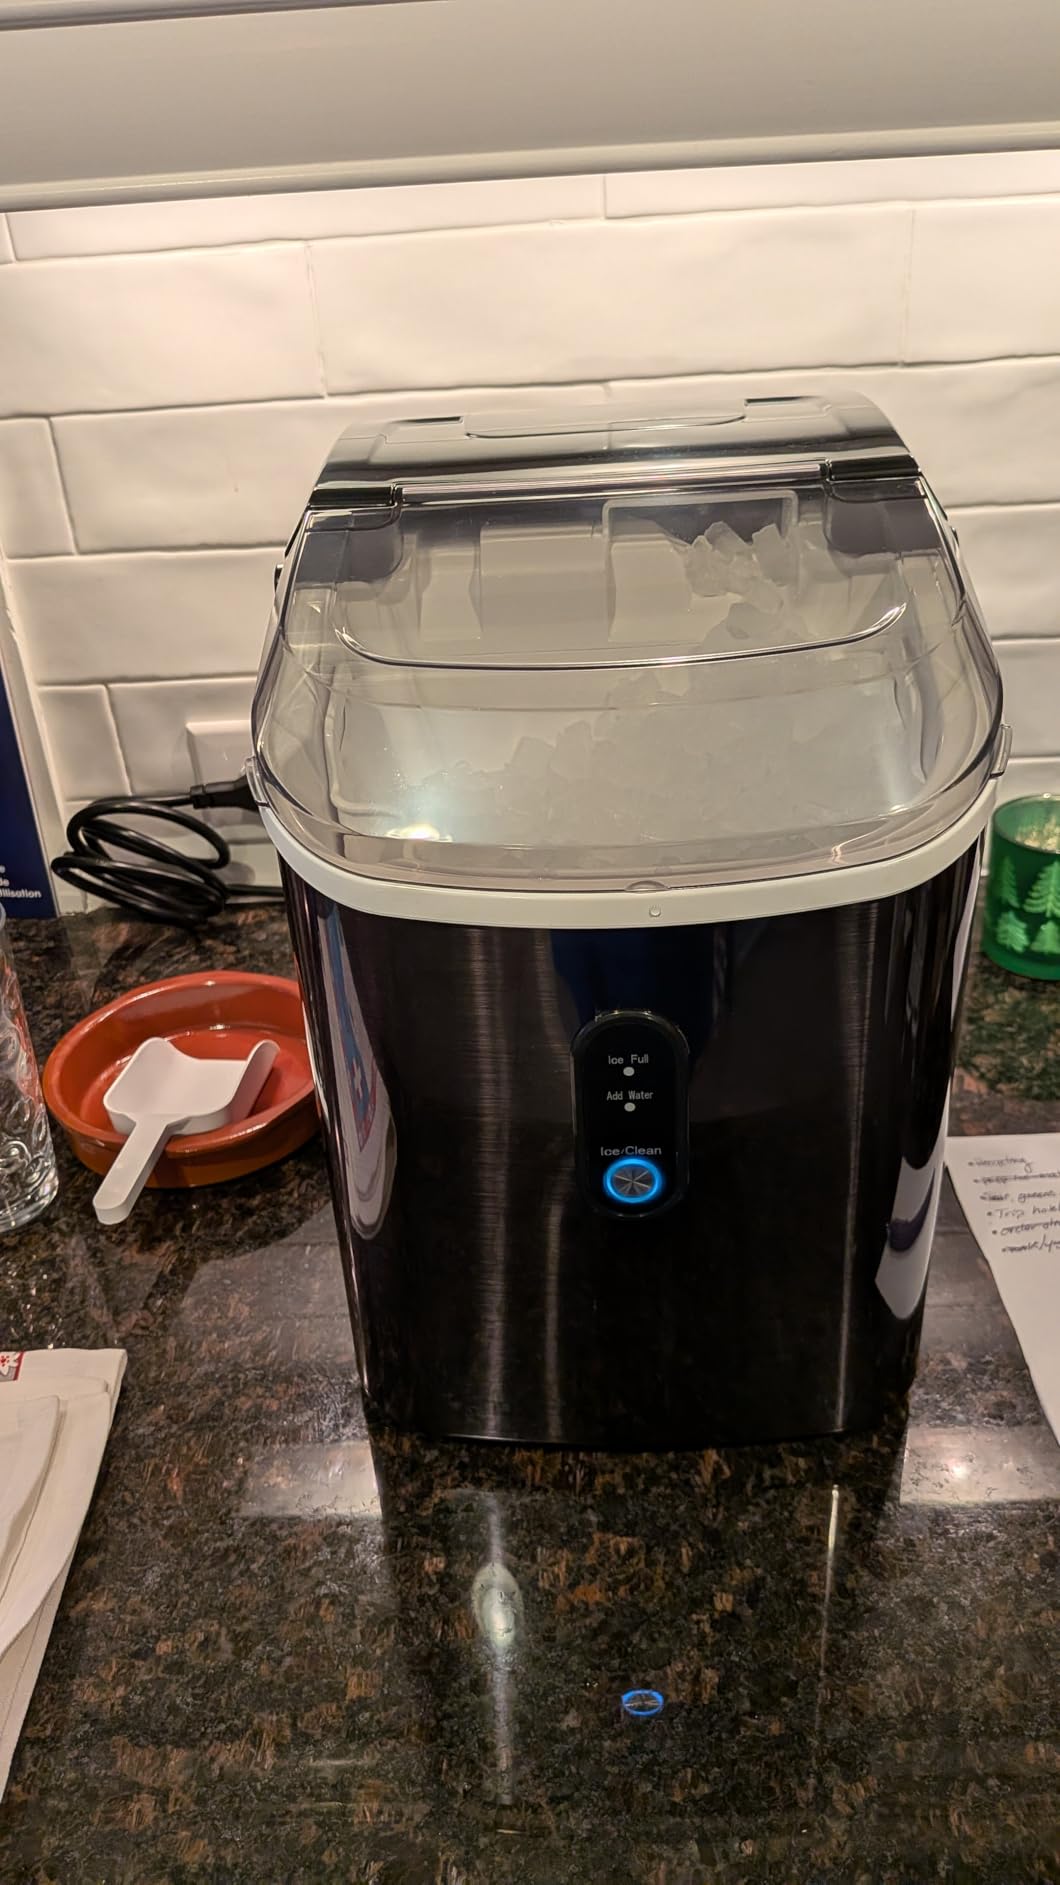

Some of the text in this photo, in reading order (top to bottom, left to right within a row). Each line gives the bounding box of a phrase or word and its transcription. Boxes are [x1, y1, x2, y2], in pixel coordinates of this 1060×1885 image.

[607, 1053, 650, 1065] Ice Full
[606, 1090, 654, 1101] Add Water
